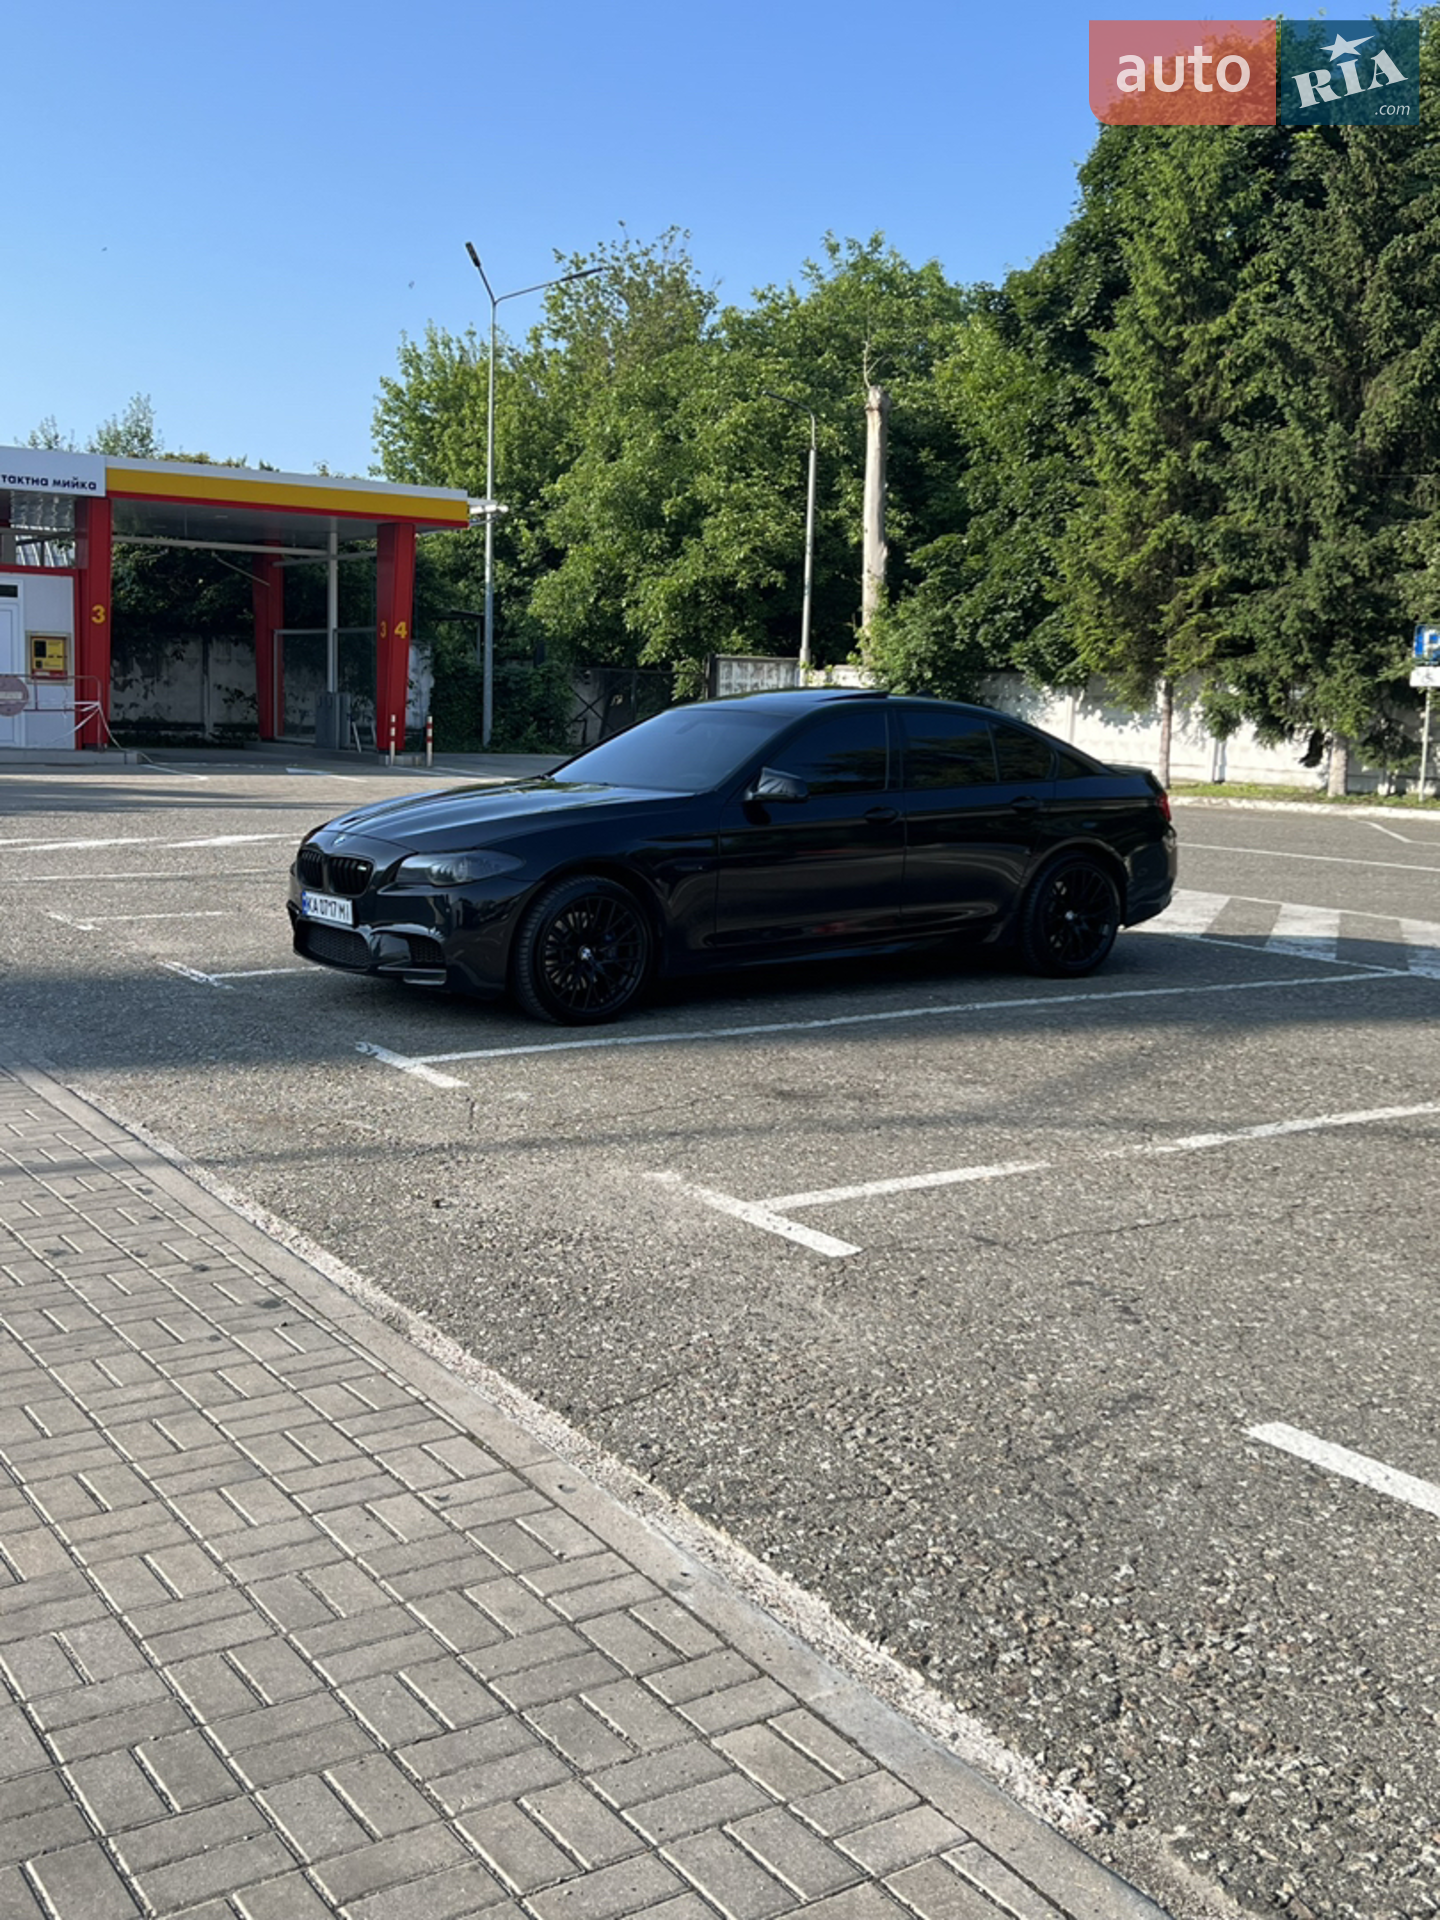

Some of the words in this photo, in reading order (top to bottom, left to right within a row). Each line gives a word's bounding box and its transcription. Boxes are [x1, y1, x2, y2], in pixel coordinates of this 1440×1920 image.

[1, 474, 49, 487] тактна
[52, 476, 97, 490] мийка
[91, 604, 106, 624] 3
[380, 620, 387, 638] 3
[394, 621, 408, 639] 4
[1423, 629, 1440, 659] P
